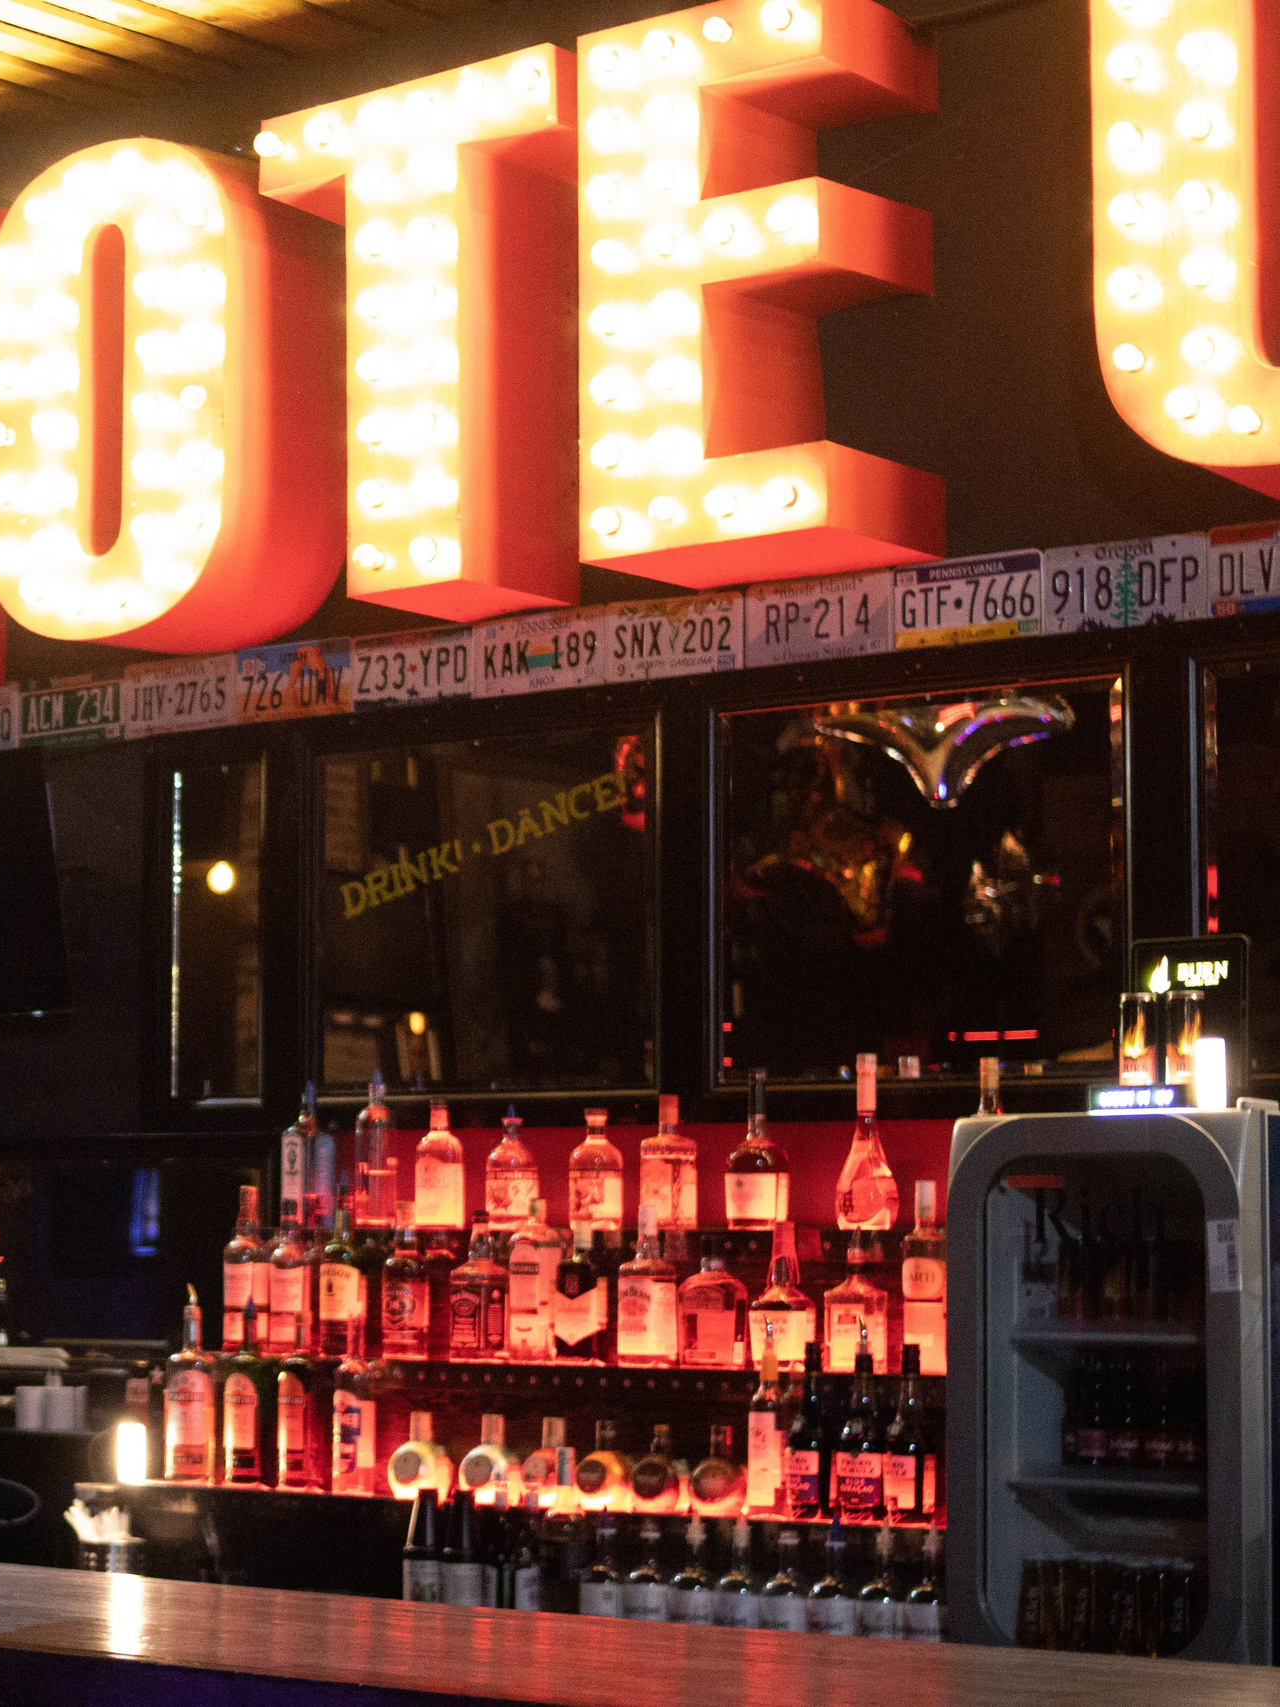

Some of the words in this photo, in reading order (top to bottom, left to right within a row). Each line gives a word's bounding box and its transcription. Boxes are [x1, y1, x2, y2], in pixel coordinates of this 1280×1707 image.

[928, 560, 1006, 580] PENNSYLVANIA
[1094, 541, 1154, 561] Oregon
[1219, 546, 1274, 597] DLV
[820, 575, 857, 595] Island
[1051, 565, 1113, 615] 918
[1138, 555, 1199, 607] DFP
[613, 620, 662, 659] SNX
[683, 616, 731, 654] 202
[765, 593, 870, 645] RP-214
[483, 640, 530, 679] KAK
[551, 630, 597, 669] 189
[76, 685, 114, 725] 234
[242, 672, 283, 713] 726
[1177, 960, 1229, 981] BURN
